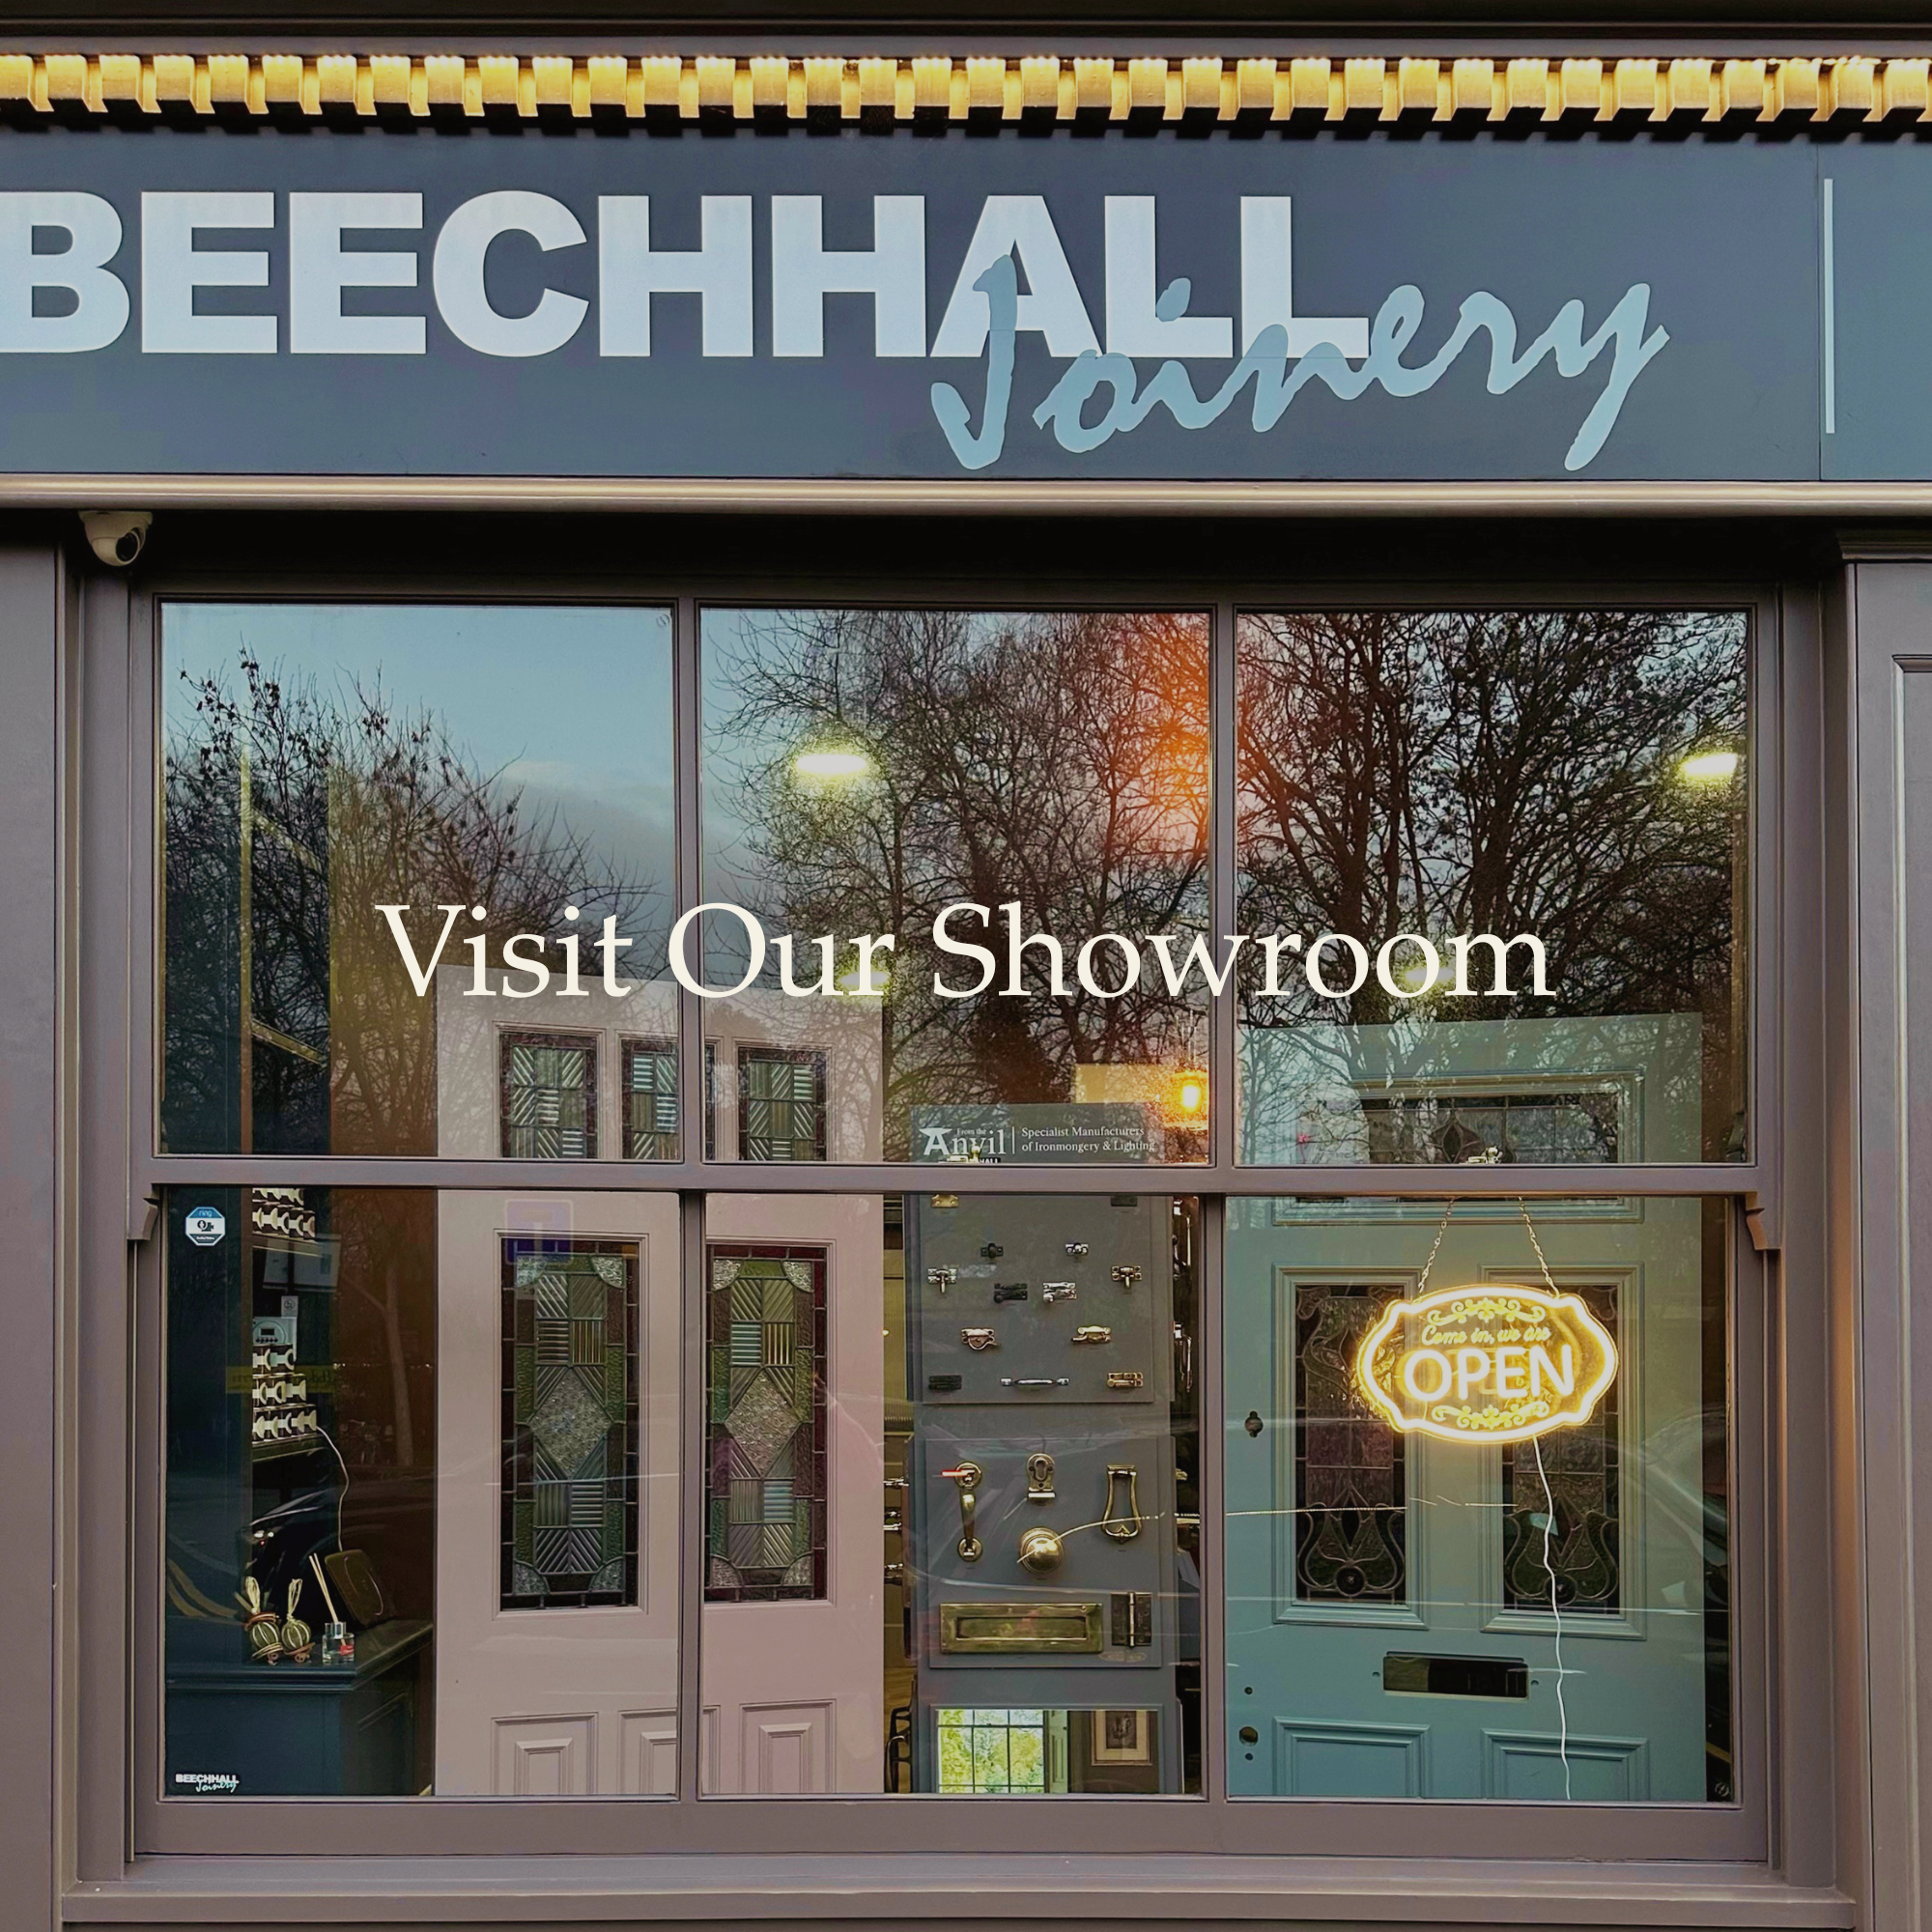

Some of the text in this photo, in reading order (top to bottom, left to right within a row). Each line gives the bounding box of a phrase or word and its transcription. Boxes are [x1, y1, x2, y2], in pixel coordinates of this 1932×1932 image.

[0, 190, 1370, 359] BEECHHALL
[930, 254, 1670, 470] Joinery
[919, 1127, 1007, 1155] Anvil
[1021, 1125, 1145, 1139] Specialist Manufacturers
[1021, 1140, 1156, 1153] of Ironmongery & Lighting
[1421, 1323, 1467, 1346] Come
[1497, 1329, 1520, 1342] we
[1404, 1344, 1575, 1401] OPEN
[176, 1774, 240, 1783] BEECHHALL
